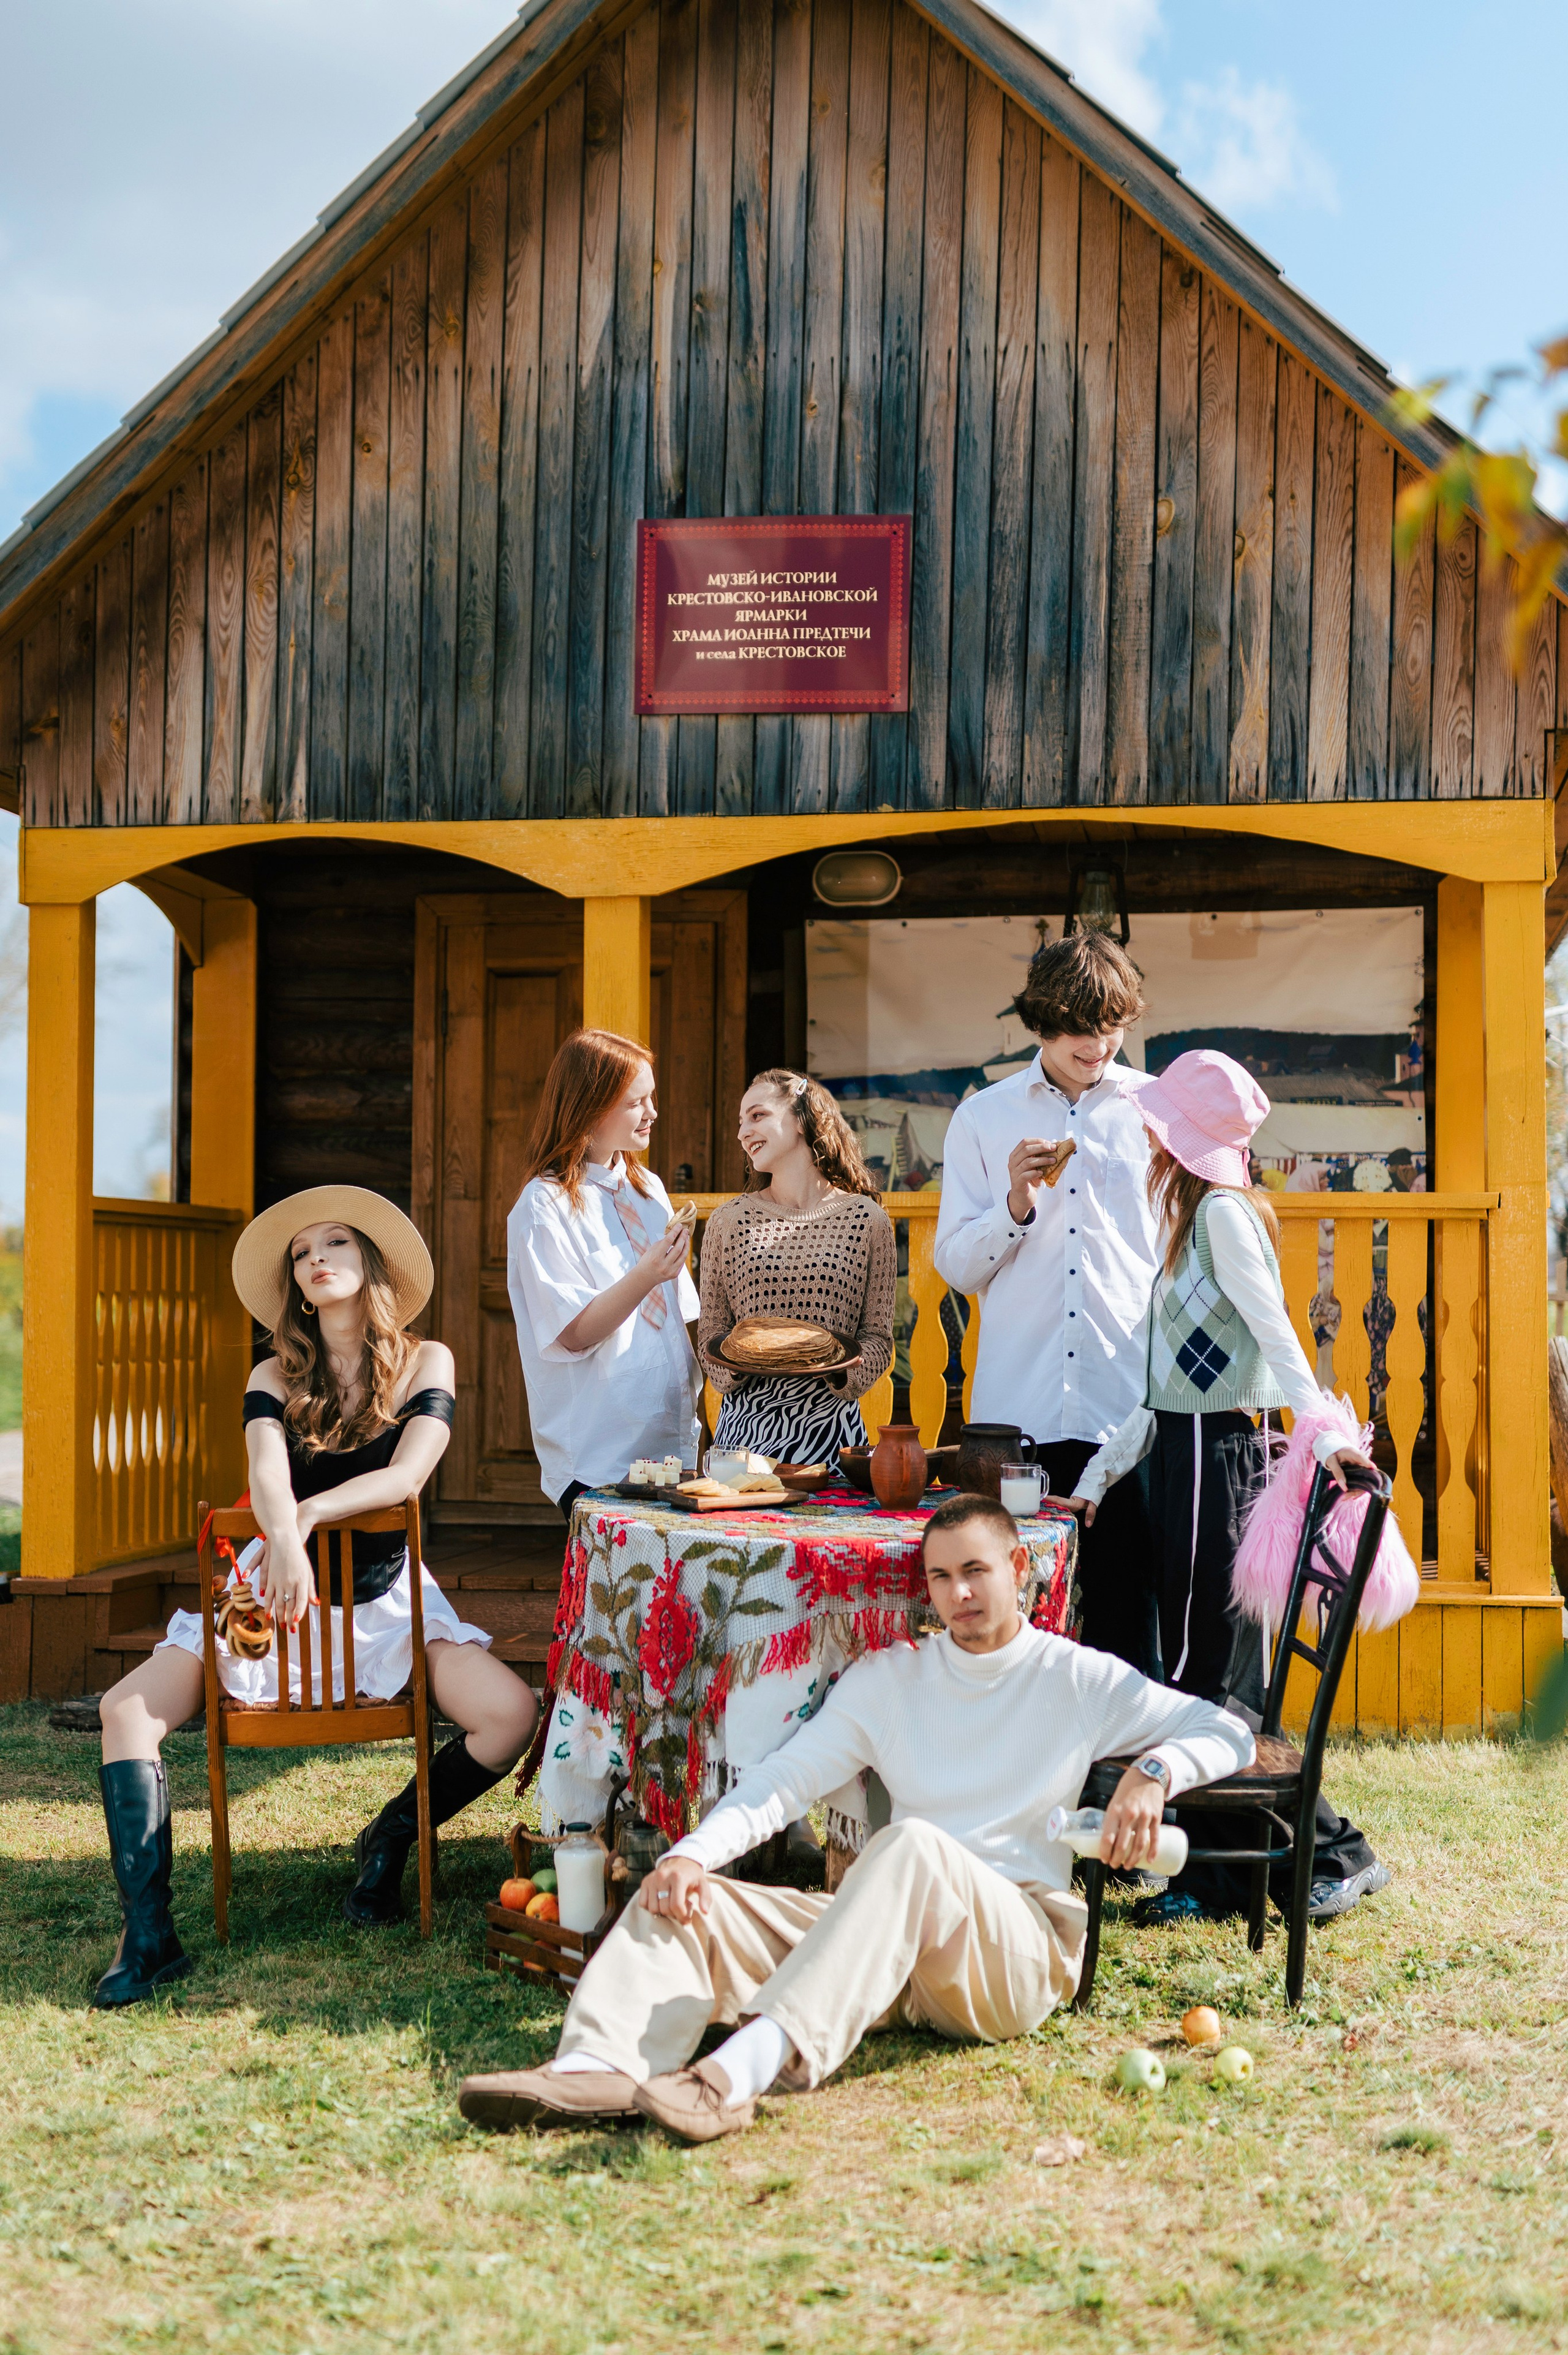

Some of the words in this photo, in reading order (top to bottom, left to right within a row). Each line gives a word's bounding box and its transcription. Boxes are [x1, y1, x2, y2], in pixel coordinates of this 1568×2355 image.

[707, 570, 758, 588] МУЗЕЙ
[761, 572, 837, 584] ИСТОРИИ
[667, 587, 878, 605] КРЕСТОВСКО-ИВАНОВСКОЙ
[734, 609, 807, 622] ЯРМАРКИ
[673, 629, 722, 641] ХРАМА
[724, 628, 790, 641] ИОАННА
[793, 627, 871, 641] ПРЕДТЕЧИ
[707, 651, 736, 659] села
[738, 646, 846, 659] КРЕСТОВСКОЕ
